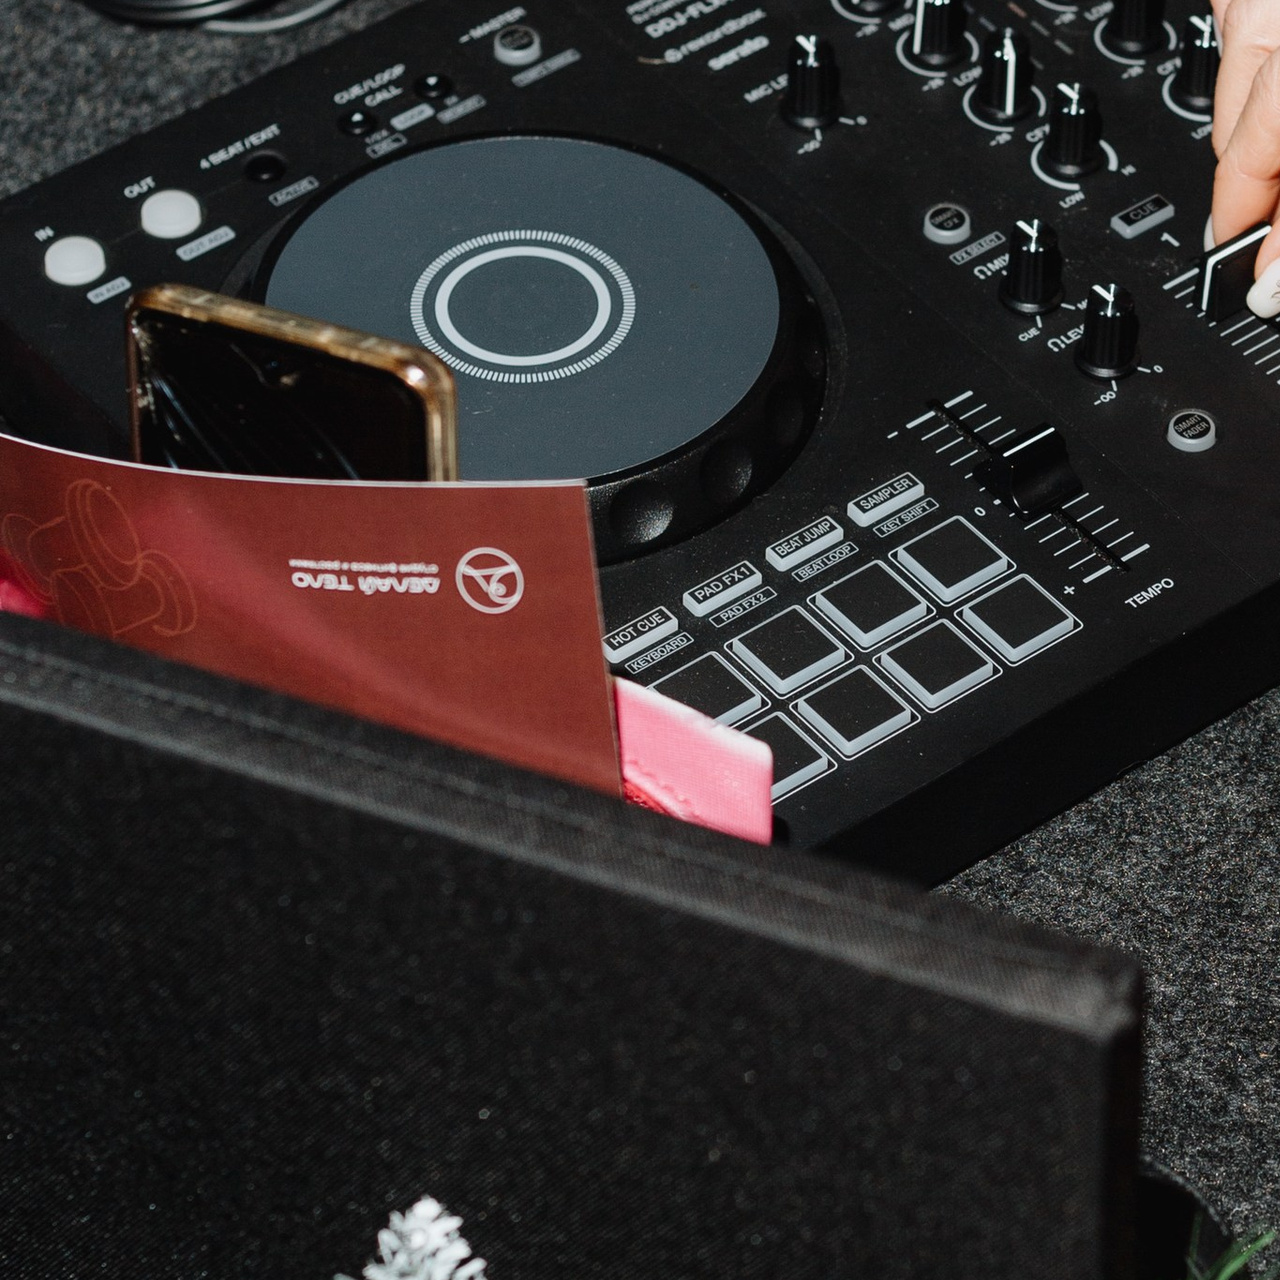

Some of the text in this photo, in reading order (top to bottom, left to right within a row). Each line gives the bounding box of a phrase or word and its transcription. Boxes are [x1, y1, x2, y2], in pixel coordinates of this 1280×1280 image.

[123, 175, 156, 199] OUT
[1129, 202, 1158, 220] CUE
[1160, 232, 1180, 248] 1
[1018, 327, 1041, 343] CUE
[1061, 323, 1086, 346] LEV
[1174, 414, 1202, 433] SMART
[1182, 421, 1210, 440] FADER
[860, 477, 914, 511] SAMPLER
[880, 502, 932, 535] KEY SHIFT
[974, 506, 987, 518] 0
[775, 521, 833, 557] BEAT JUMP
[798, 545, 852, 580] BEAT LOOP
[291, 571, 441, 596] ДЕЛАЙ ТЕЛО
[694, 581, 724, 601] PAD
[1124, 577, 1175, 609] TEMPO
[719, 605, 744, 622] PAD
[610, 612, 666, 647] HOT CUE
[630, 636, 688, 671] KEYBOARD
